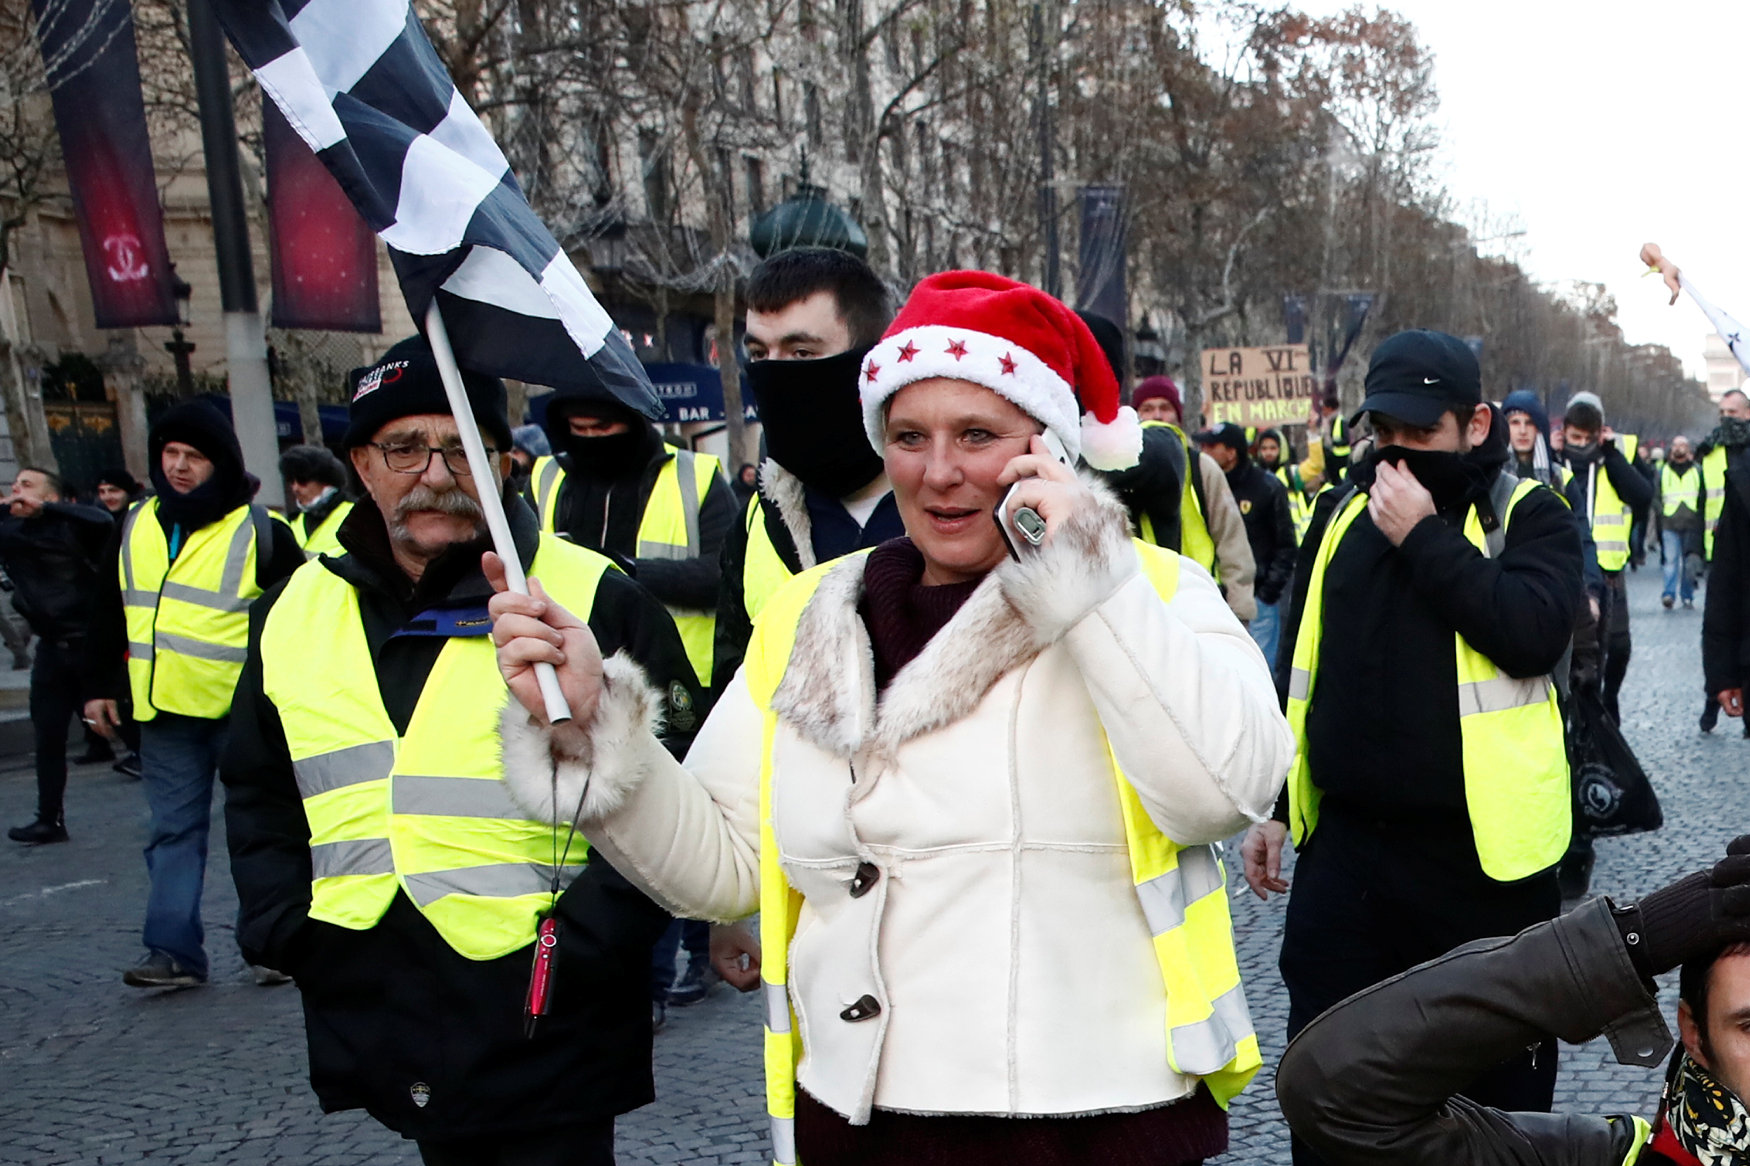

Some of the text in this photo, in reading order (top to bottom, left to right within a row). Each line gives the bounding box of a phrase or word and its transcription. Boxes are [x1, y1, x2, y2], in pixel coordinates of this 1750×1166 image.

[1210, 351, 1242, 376] LA
[678, 406, 710, 421] BAR
[1213, 402, 1243, 424] EN
